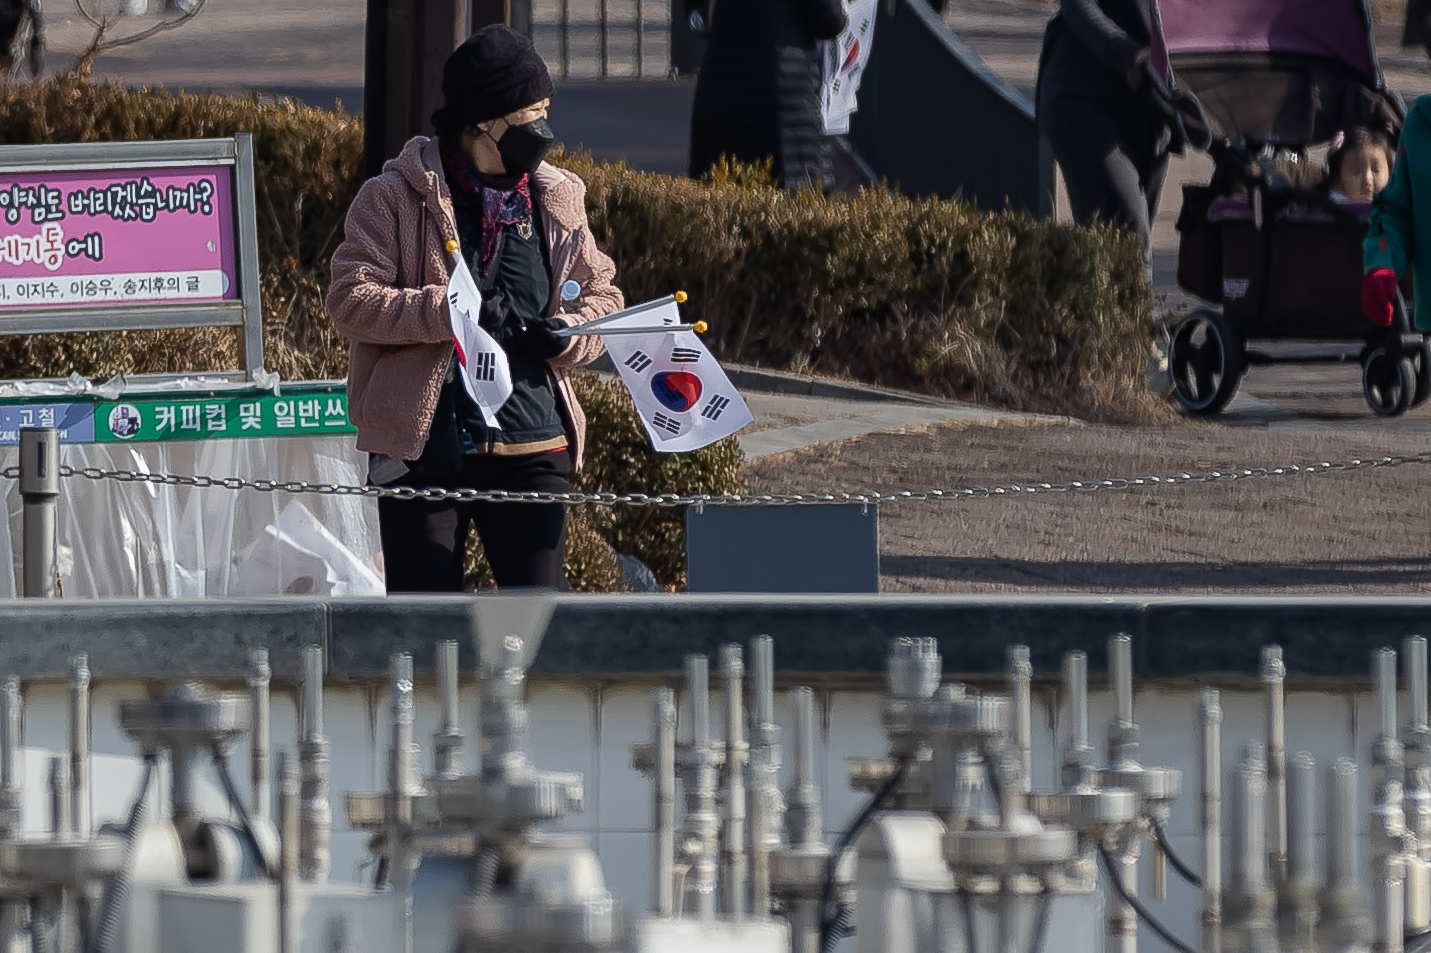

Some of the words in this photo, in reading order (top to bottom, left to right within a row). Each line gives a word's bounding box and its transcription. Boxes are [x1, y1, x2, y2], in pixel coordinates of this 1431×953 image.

[0, 183, 65, 224] 양심도
[68, 177, 213, 220] 버리겠습니까?
[16, 281, 64, 298] 이지수,
[186, 276, 200, 292] 글
[155, 404, 227, 432] 커피컵
[240, 402, 262, 430] 및
